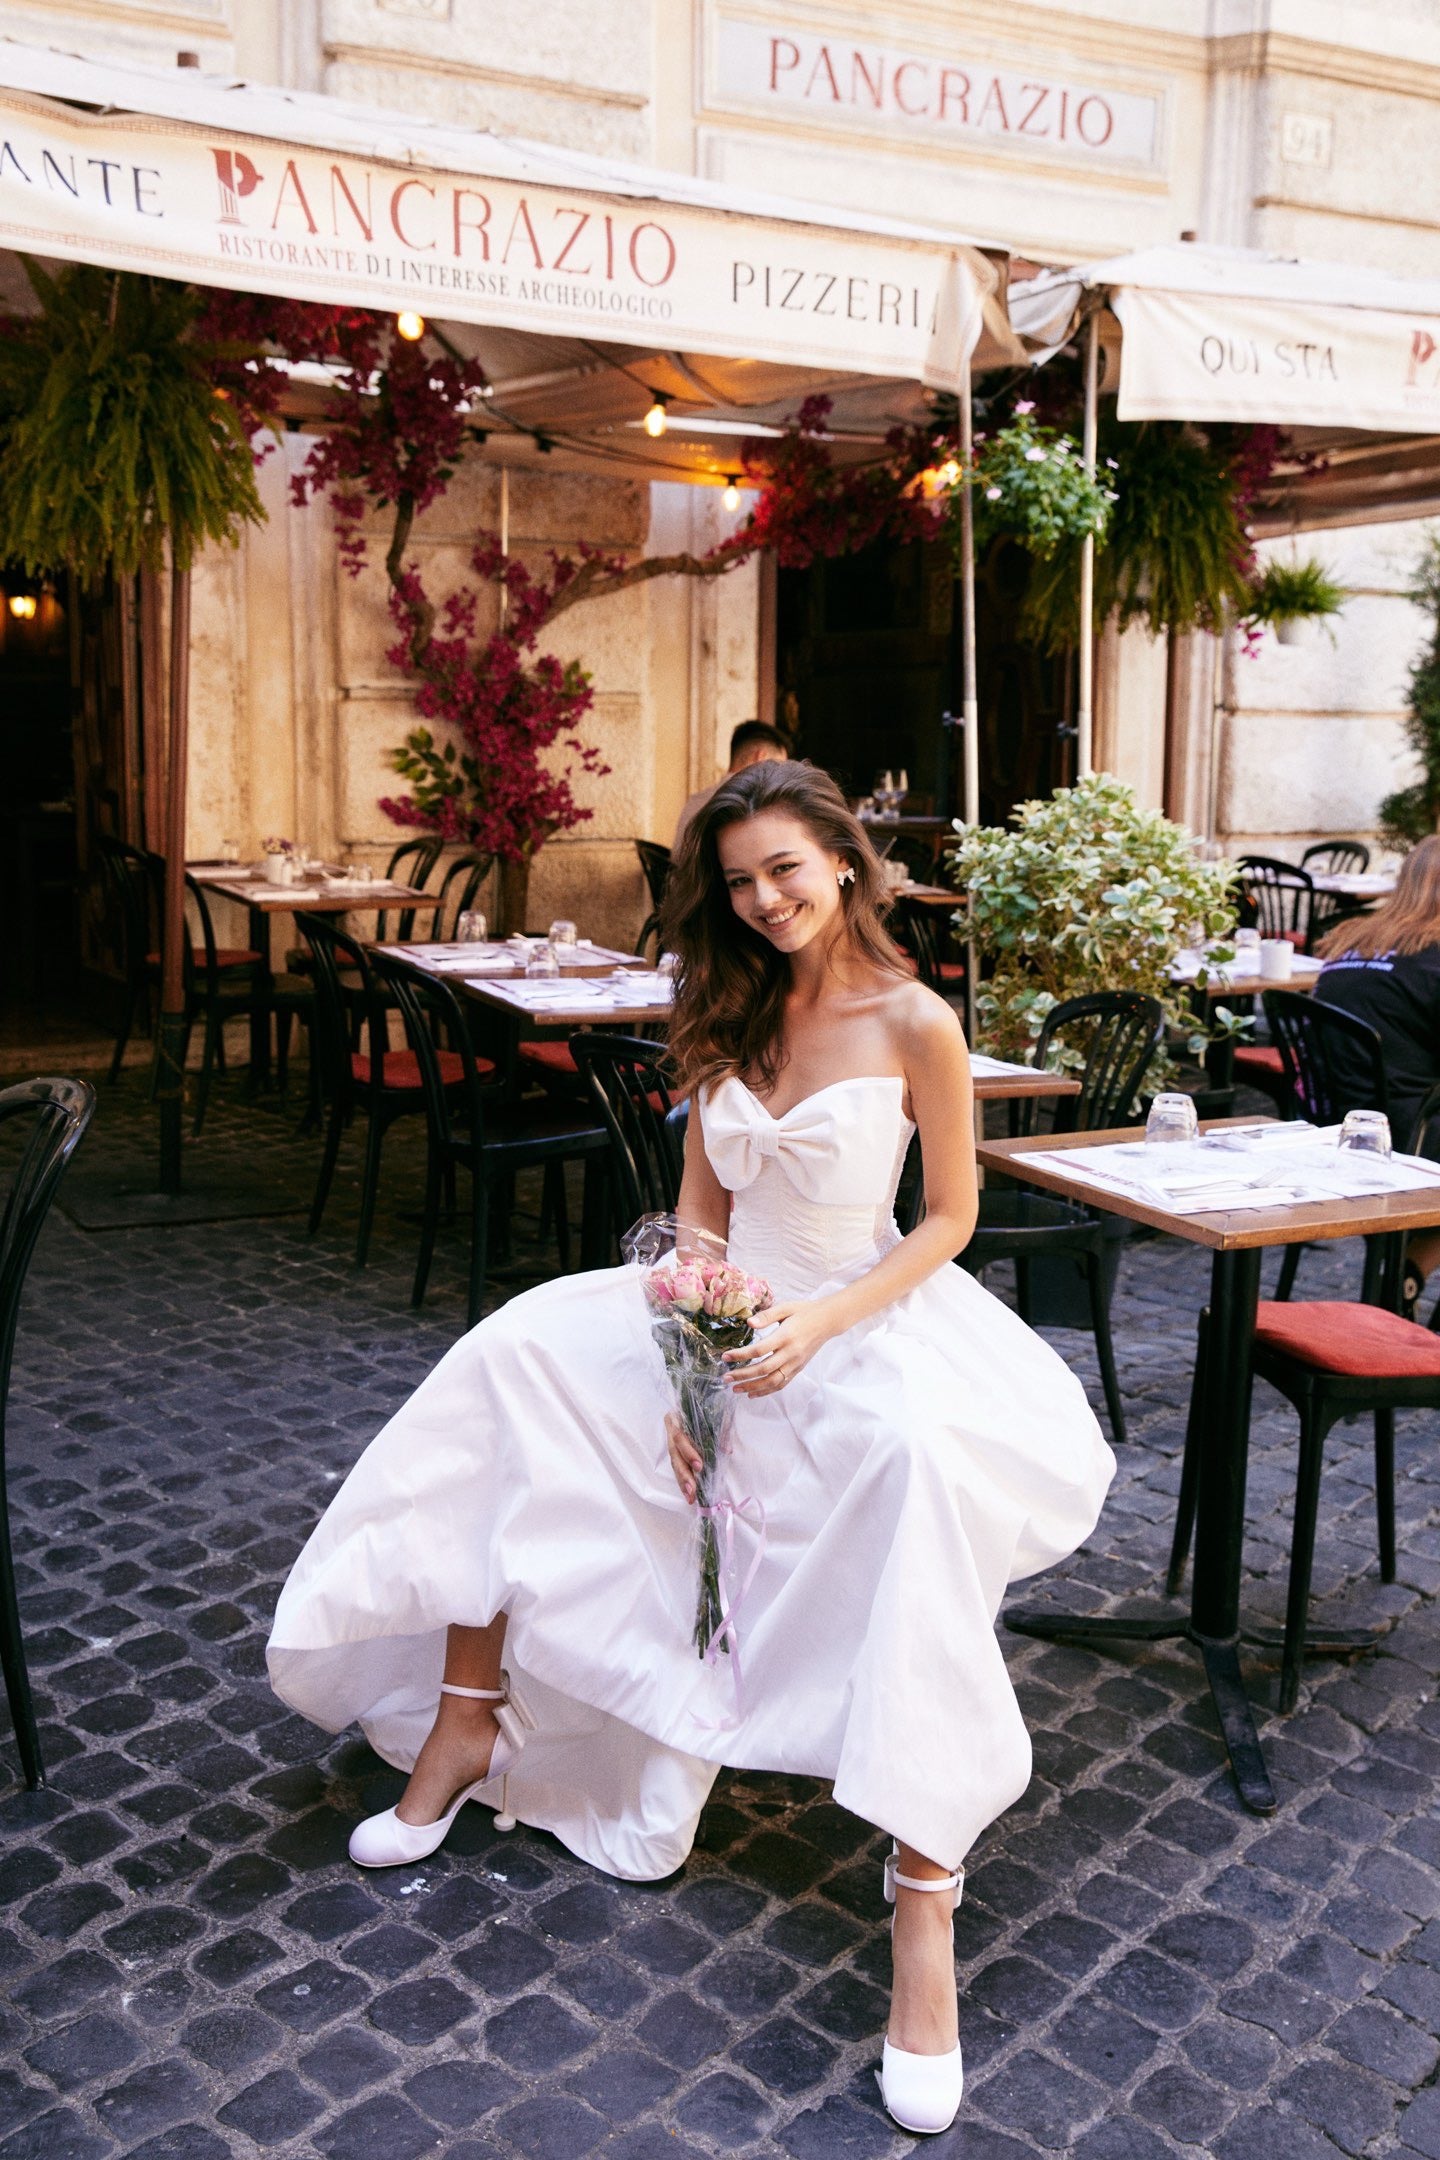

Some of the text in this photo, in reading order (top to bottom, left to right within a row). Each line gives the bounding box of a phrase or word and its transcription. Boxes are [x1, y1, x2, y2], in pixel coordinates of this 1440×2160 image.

[769, 37, 1114, 148] PANCRAZIO
[0, 141, 164, 218] ANTE
[207, 148, 676, 288] PANCRAZIO
[218, 233, 673, 321] RISTORANTE DI INTERESSE ARCHEOLOGICO
